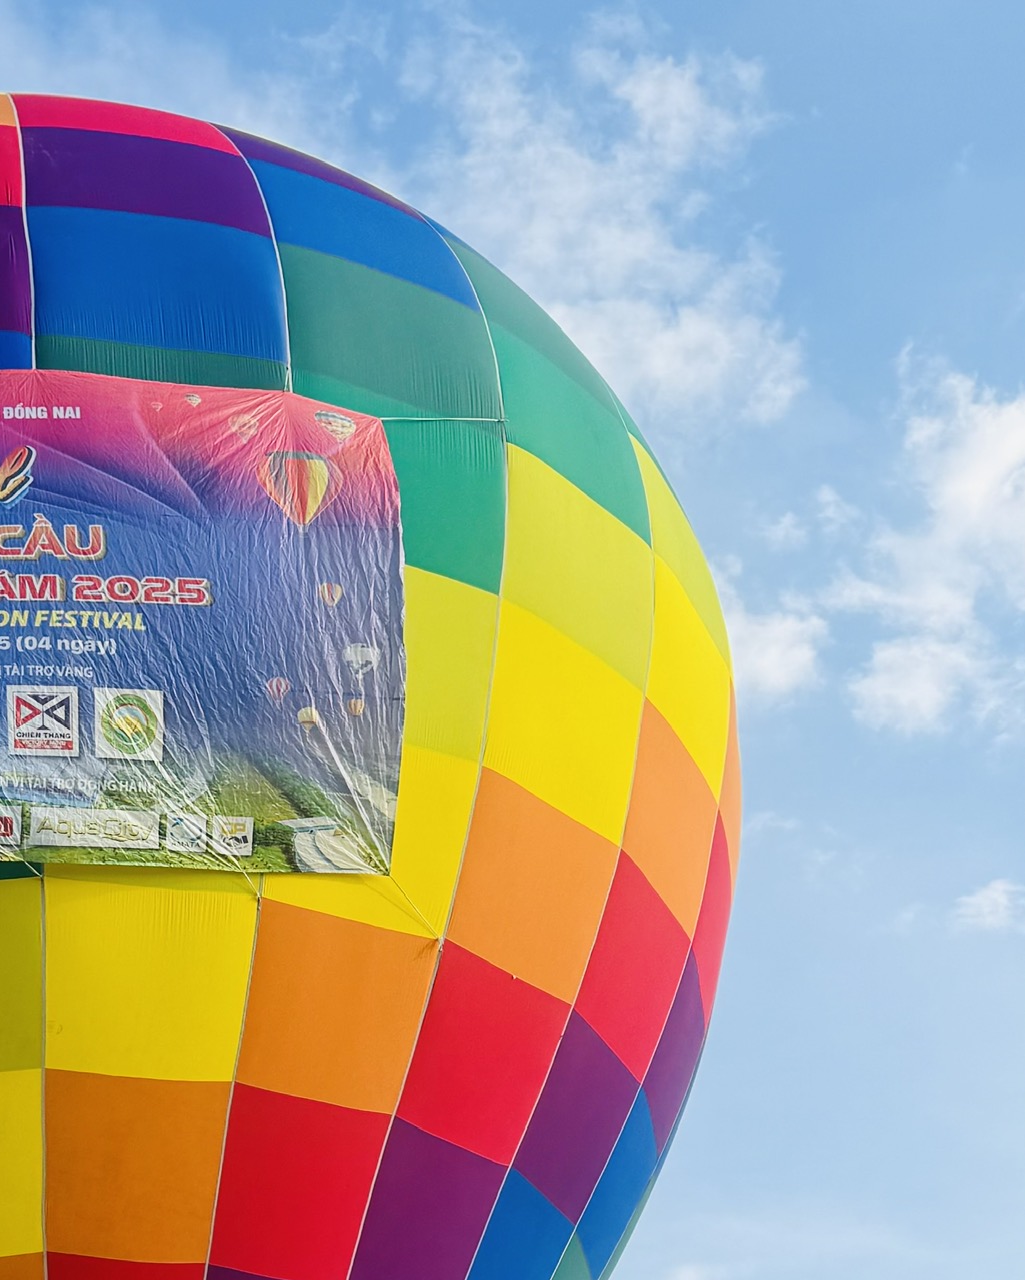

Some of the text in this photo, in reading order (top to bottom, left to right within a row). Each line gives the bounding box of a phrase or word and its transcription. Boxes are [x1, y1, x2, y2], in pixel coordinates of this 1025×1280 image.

[2, 401, 49, 420] ĐỒNG
[52, 406, 82, 420] NAI
[73, 573, 213, 605] 2025
[33, 610, 146, 631] FESTIVAL
[16, 637, 52, 652] (04
[57, 635, 117, 656] ngày)
[4, 662, 25, 677] TÀI
[26, 663, 55, 679] TRỢ
